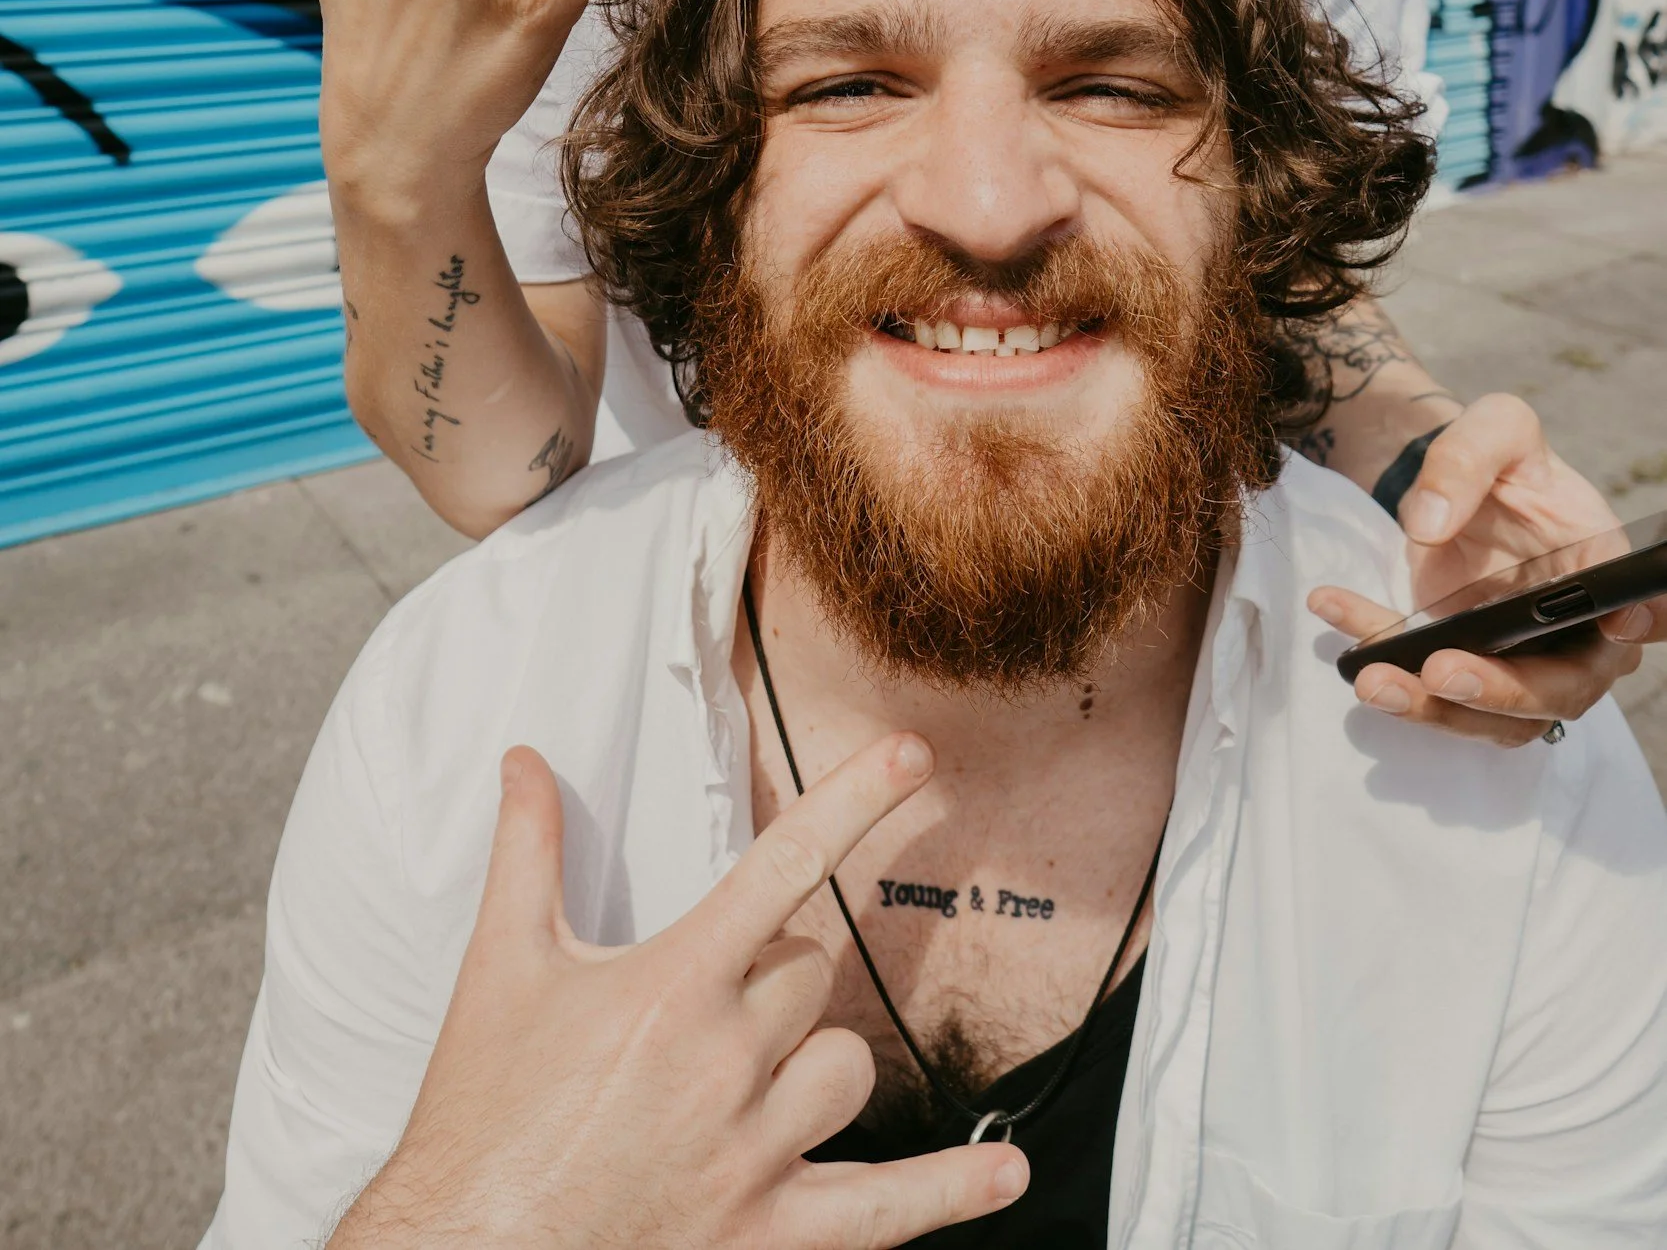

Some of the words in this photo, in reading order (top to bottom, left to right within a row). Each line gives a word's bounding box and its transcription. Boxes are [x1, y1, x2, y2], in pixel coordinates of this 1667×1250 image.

[428, 253, 481, 333] daughter
[423, 407, 461, 427] my
[877, 879, 959, 919] Young
[970, 885, 985, 913] &
[995, 888, 1056, 920] Free
